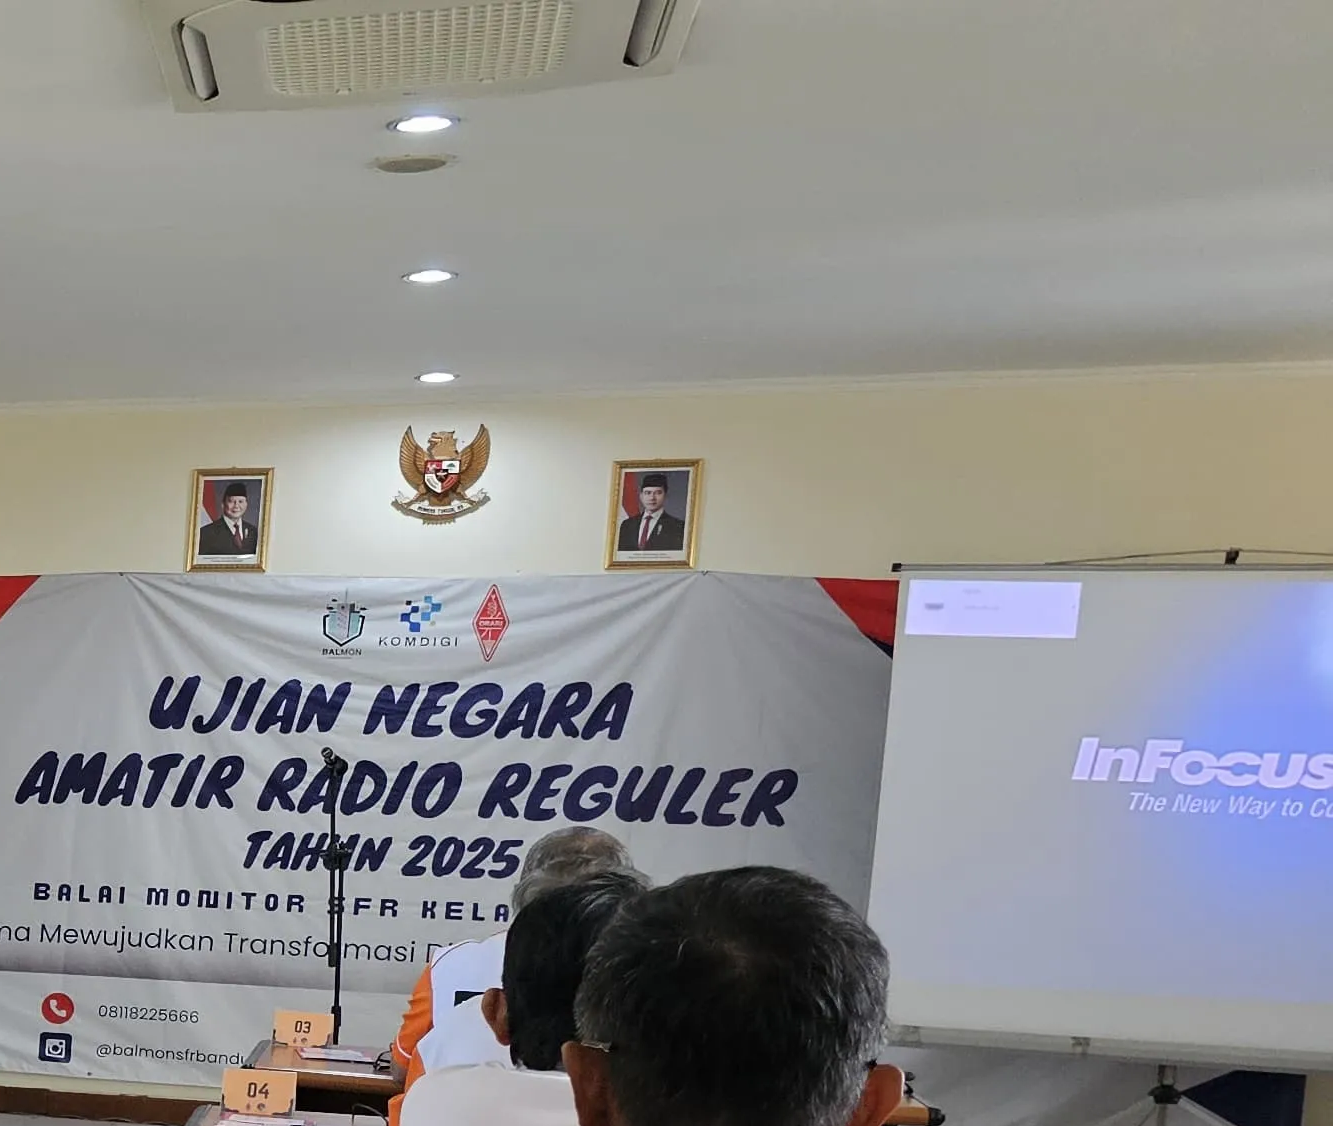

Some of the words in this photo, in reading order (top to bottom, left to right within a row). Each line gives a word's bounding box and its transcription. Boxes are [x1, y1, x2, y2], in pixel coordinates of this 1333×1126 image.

[322, 648, 362, 656] BALMON
[378, 636, 459, 647] KOMDIGI
[148, 675, 352, 734] UJIAN
[362, 681, 634, 741] NEGARA
[14, 750, 245, 809] AMATIR
[256, 756, 463, 819] RADIO
[477, 762, 799, 828] REGULER
[1128, 792, 1167, 812] The
[1171, 793, 1222, 814] New
[1227, 795, 1278, 820] Way
[1280, 797, 1303, 818] to
[400, 834, 524, 879] 2025
[33, 882, 126, 904] BALAI
[146, 887, 306, 913] MONITOR
[421, 900, 510, 922] KELA
[39, 923, 214, 953] Mewujudkan
[223, 932, 416, 963] Transfomasi
[98, 1005, 200, 1024] 08118225666
[294, 1020, 312, 1034] 03
[246, 1081, 270, 1099] 04
